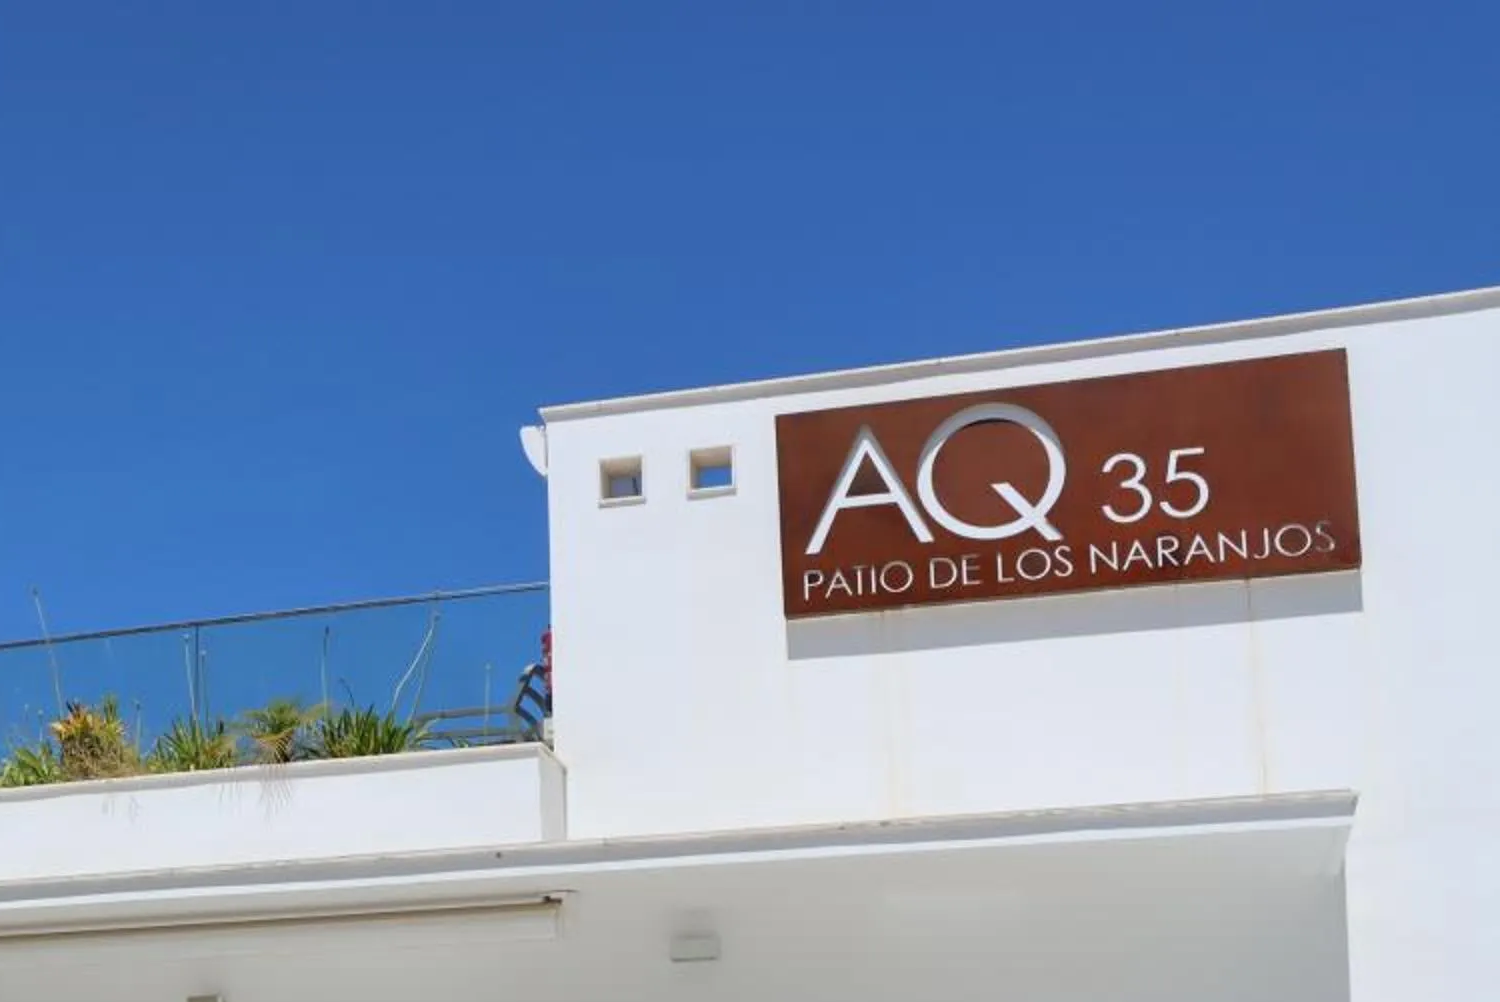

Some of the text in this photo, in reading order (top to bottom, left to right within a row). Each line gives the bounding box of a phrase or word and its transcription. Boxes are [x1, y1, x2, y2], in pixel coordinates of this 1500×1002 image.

[804, 402, 1211, 556] AQ 35
[802, 519, 1337, 601] PATIO DE LOS NARANJOS
